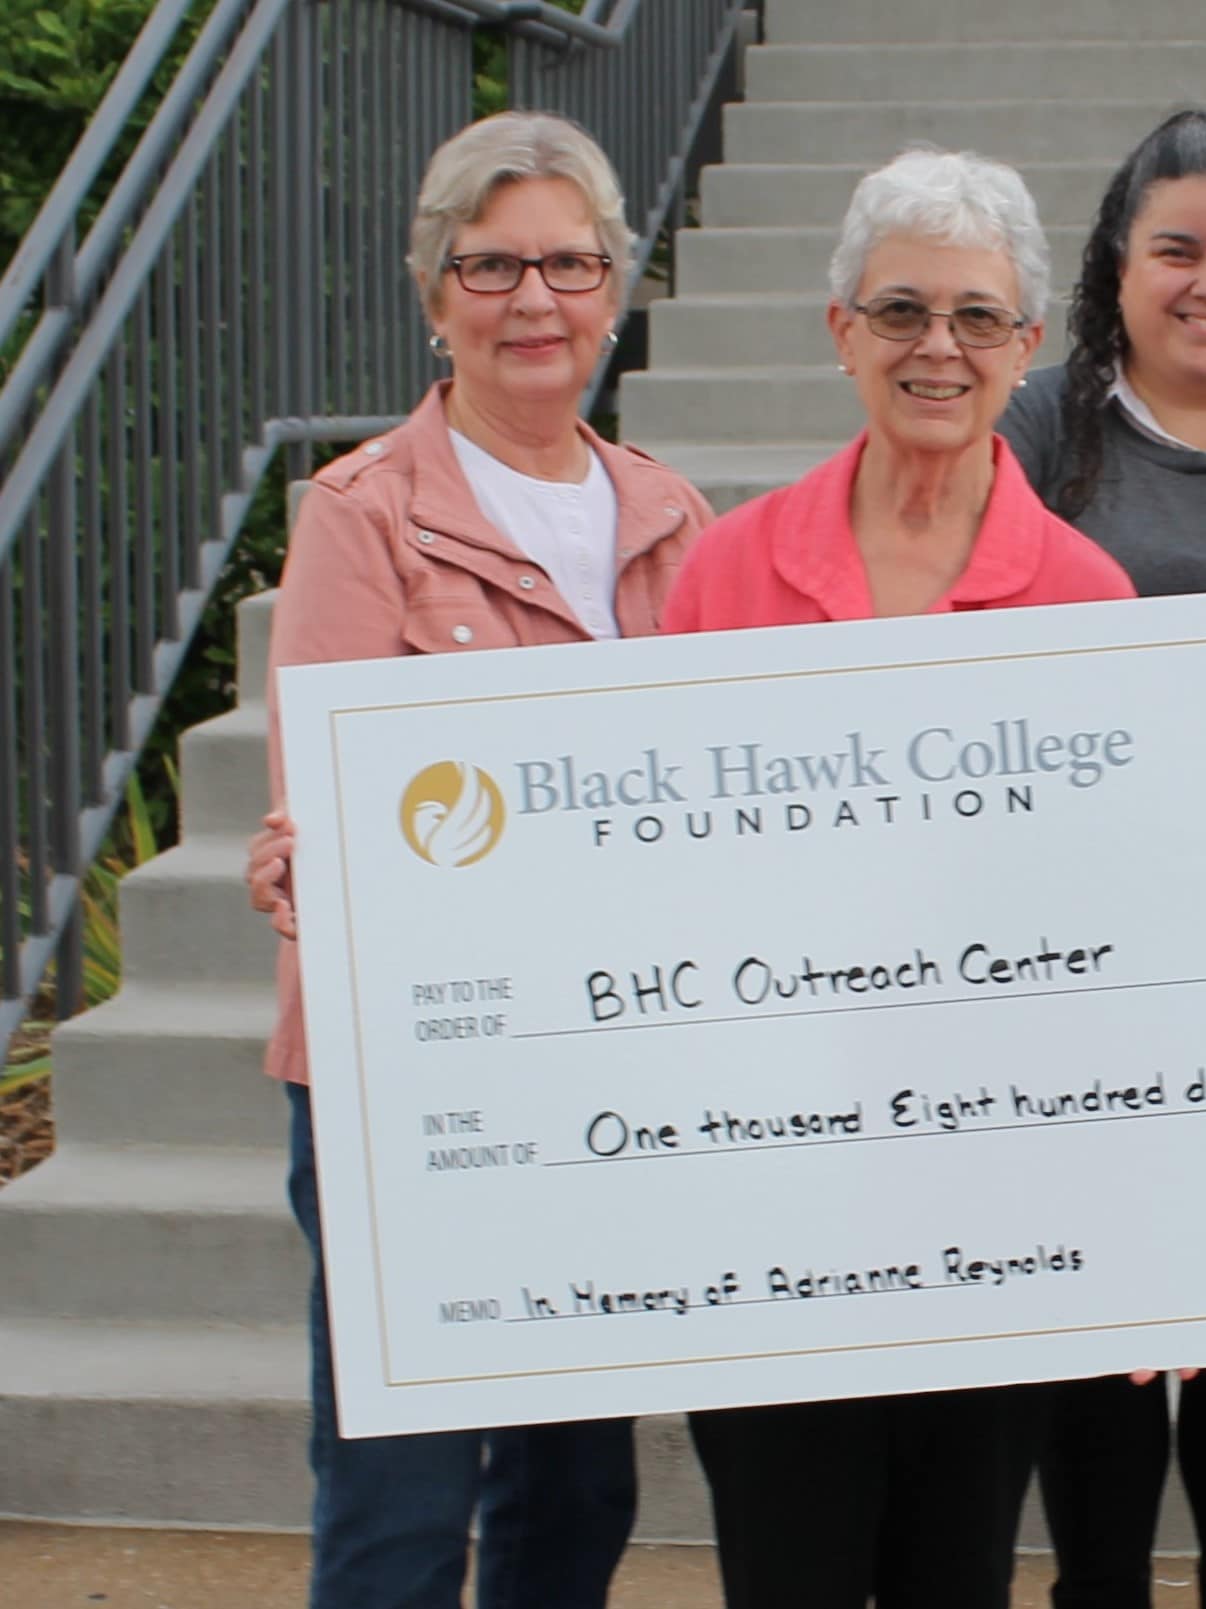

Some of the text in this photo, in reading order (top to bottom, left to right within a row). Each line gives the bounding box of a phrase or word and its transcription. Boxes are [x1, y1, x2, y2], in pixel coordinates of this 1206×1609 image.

[515, 716, 1136, 816] Black Hawk College
[593, 784, 1035, 847] FOUNDATION
[412, 977, 512, 1005] PAY TO THE
[585, 937, 1114, 1022] BHC Outreach Center
[415, 1014, 507, 1042] ORDER OF
[423, 1109, 483, 1135] IN THE
[587, 1110, 681, 1158] One
[700, 1102, 864, 1143] thousand
[890, 1088, 999, 1131] Eight
[1009, 1072, 1165, 1118] hundred
[426, 1142, 538, 1171] AMOUNT OF
[522, 1244, 1085, 1318] In Memory of Adrianne Reynolds
[439, 1299, 501, 1324] MEMO
